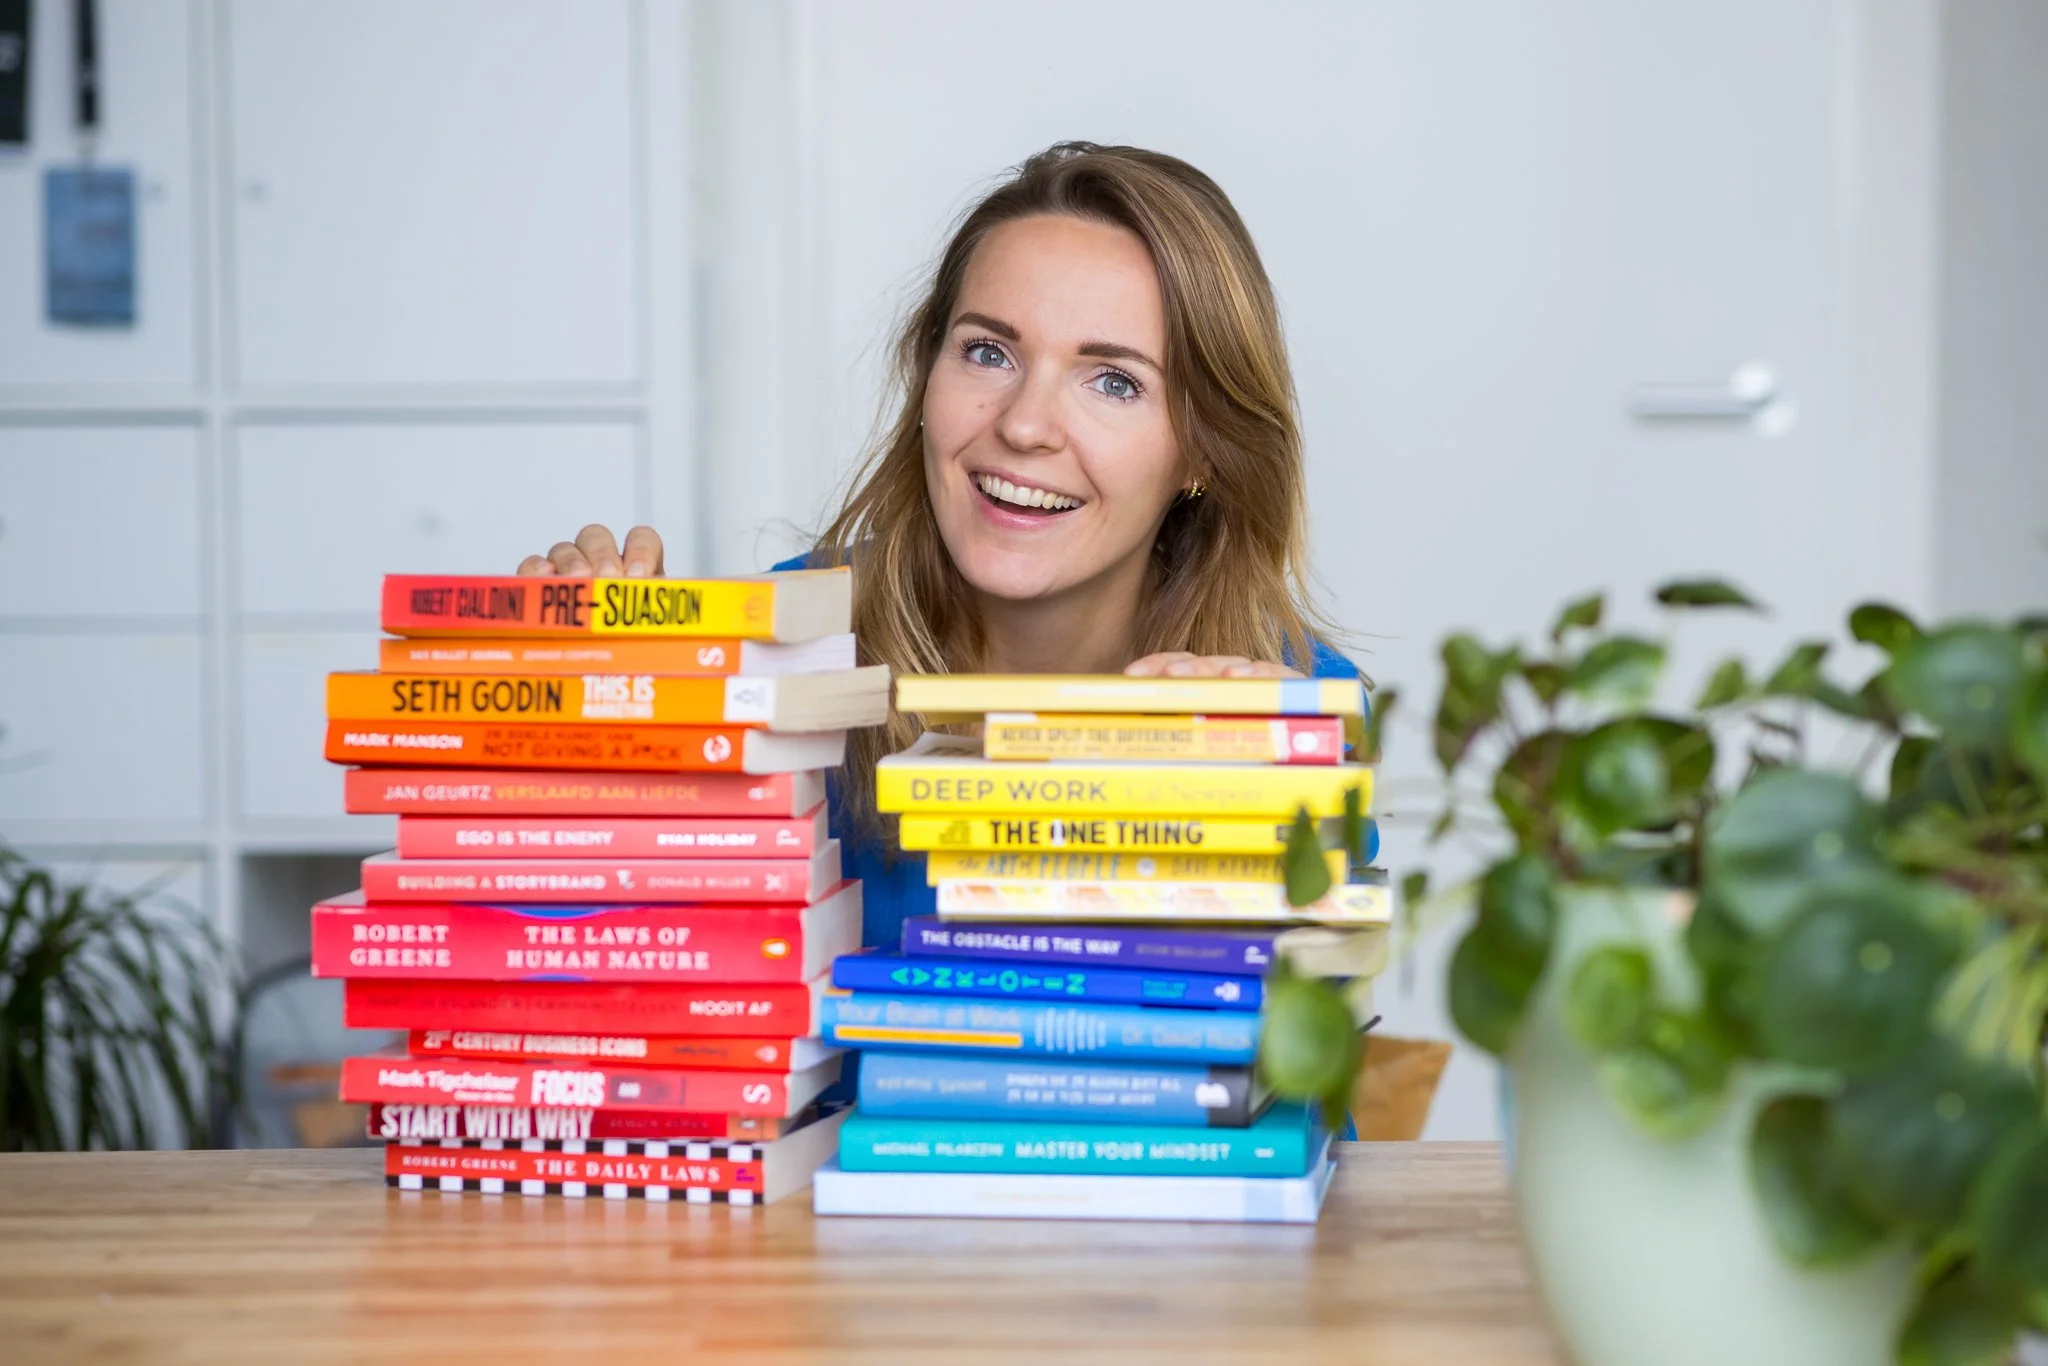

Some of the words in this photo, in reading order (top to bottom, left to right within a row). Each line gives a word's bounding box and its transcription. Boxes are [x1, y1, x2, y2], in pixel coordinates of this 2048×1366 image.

[392, 679, 461, 711] SETH
[472, 680, 562, 712] GODIN
[581, 675, 630, 702] THIS
[633, 675, 656, 702] IS
[344, 733, 391, 747] MARK
[392, 734, 464, 749] MANSON
[483, 743, 523, 757] NOT
[530, 743, 601, 758] GIVING
[610, 744, 623, 757] A
[383, 785, 419, 800] JAN
[422, 785, 491, 801] GEURTZ
[495, 785, 594, 800] VERSLAAFD
[598, 785, 637, 800] AAN
[641, 785, 700, 801] LIEFDE
[911, 778, 995, 801] DEEP
[1006, 779, 1108, 802] WORK
[456, 830, 494, 845] EGO
[496, 830, 515, 845] IS
[517, 830, 551, 845] THE
[553, 831, 614, 845] ENEMY
[656, 833, 695, 846] RYAN
[696, 833, 758, 847] HOLIDAY
[990, 820, 1042, 844] THE
[1050, 820, 1106, 846] ONE
[1115, 820, 1205, 845] THING
[1039, 853, 1122, 879] PEOPLE
[397, 876, 476, 889] BUILDING
[479, 876, 492, 889] A
[495, 875, 606, 890] STORYBRAND
[352, 924, 450, 942] ROBERT
[524, 925, 577, 944] THE
[584, 926, 651, 945] LAWS
[657, 927, 691, 946] OF
[920, 930, 950, 946] THE
[953, 931, 1031, 951] OBSTACLE
[1033, 936, 1049, 952] IS
[1051, 937, 1083, 954] THE
[1085, 939, 1122, 955] WAY
[350, 948, 452, 967] GREENE
[505, 950, 600, 969] HUMAN
[607, 952, 710, 970] NATURE
[689, 1001, 746, 1016] NOOIT
[747, 1001, 773, 1016] AF
[452, 1031, 523, 1052] CENTURY
[523, 1034, 599, 1055] BUSINESS
[600, 1038, 648, 1058] ICONS
[378, 1069, 426, 1088] Mark
[531, 1070, 605, 1107] FOCUS
[379, 1105, 461, 1138] START
[464, 1105, 531, 1138] WITH
[535, 1107, 594, 1139] WHY
[1014, 1140, 1090, 1160] MASTER
[1092, 1141, 1145, 1161] YOUR
[1149, 1142, 1232, 1163] MINDSET
[402, 1155, 457, 1168] ROBERT
[461, 1157, 518, 1171] GREENE
[534, 1159, 577, 1176] THE
[586, 1161, 652, 1180] DAILY
[660, 1164, 721, 1183] LAWS
